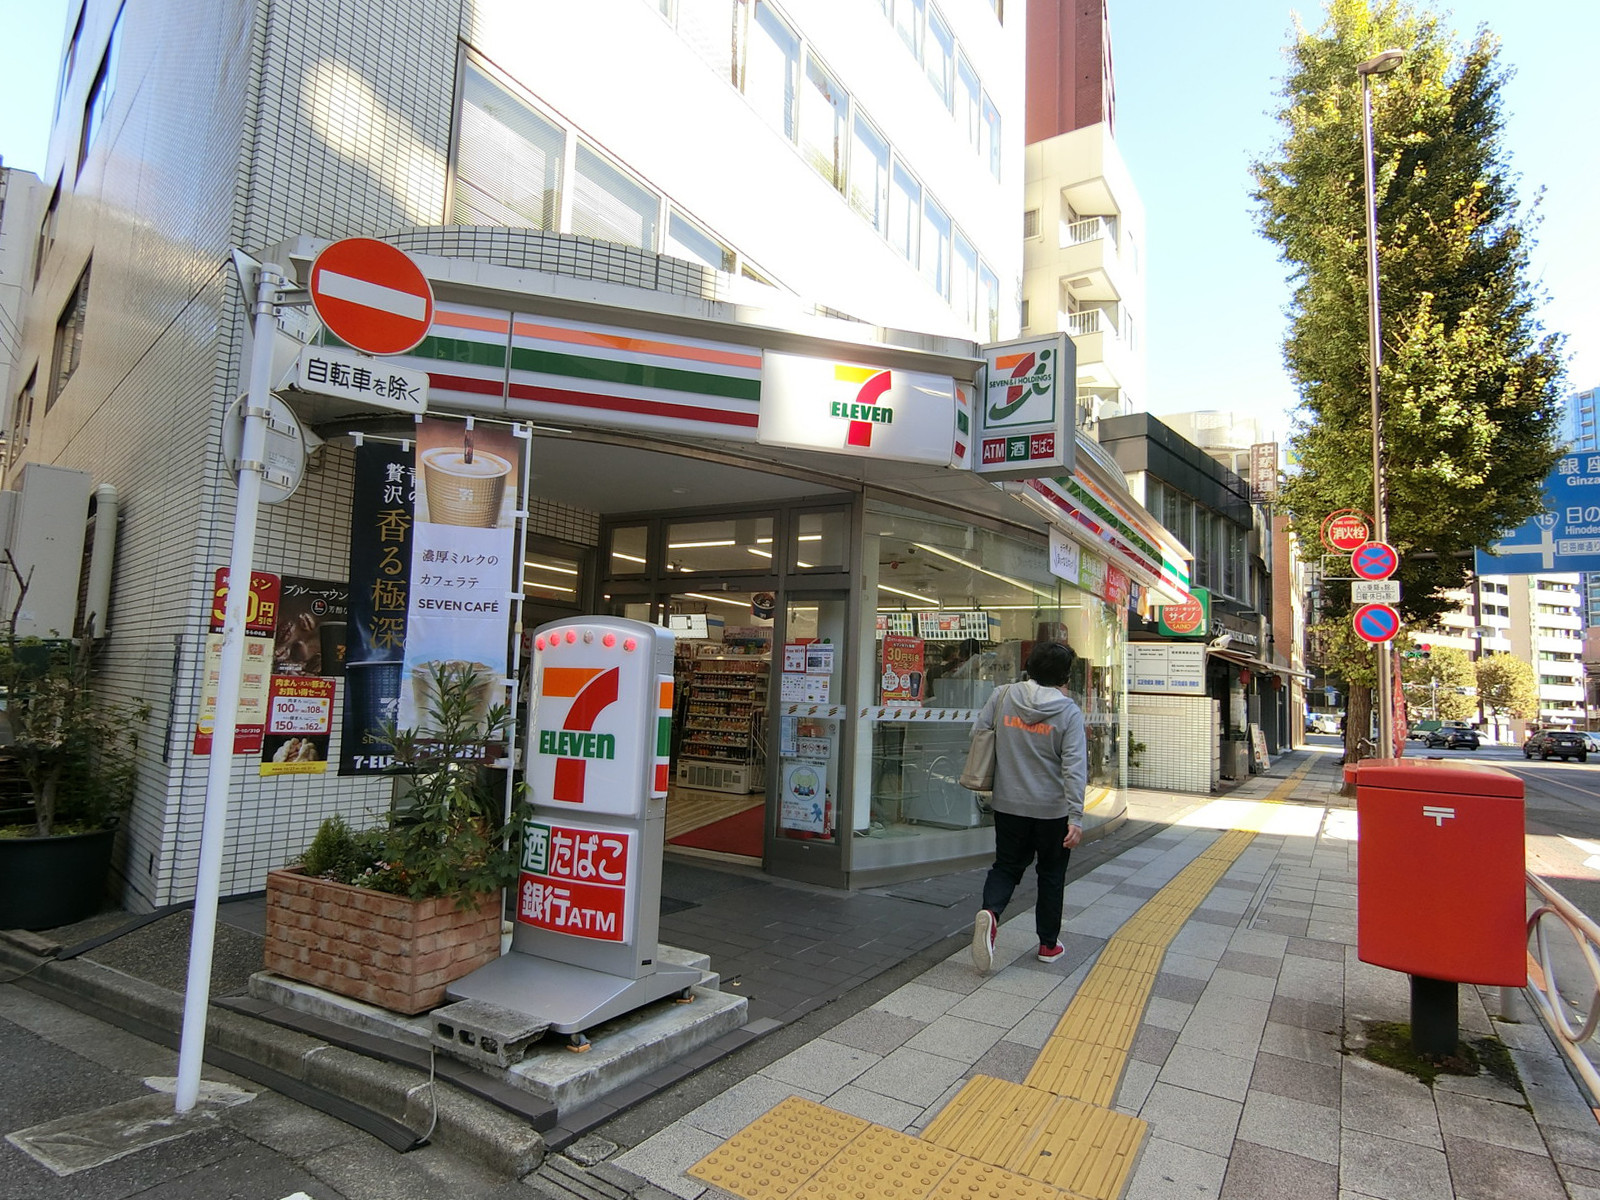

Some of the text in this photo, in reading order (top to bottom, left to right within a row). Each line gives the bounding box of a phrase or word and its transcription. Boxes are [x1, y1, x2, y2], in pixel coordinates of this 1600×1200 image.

[307, 358, 420, 404] 自転車を除く
[1018, 374, 1052, 385] HOLDINGS
[984, 444, 1005, 459] ATM
[1011, 441, 1025, 457] 酒
[1031, 439, 1053, 454] たばこ
[1258, 445, 1274, 492] 中華料理
[1558, 456, 1600, 475] 銀座
[383, 462, 405, 505] 贅沢
[1567, 476, 1600, 486] Ginza
[1539, 514, 1553, 526] 15
[1566, 507, 1600, 523] 日の
[1333, 527, 1365, 540] 消火栓
[422, 549, 498, 566] 濃厚ミルクの
[369, 509, 411, 650] 香る極深
[420, 573, 479, 588] カフェラテ
[418, 598, 499, 612] SEVEN CAFÉ
[1169, 612, 1195, 621] サイノ
[522, 826, 548, 871] 酒
[551, 831, 623, 880] たばこ
[522, 881, 616, 932] 銀行ATM
